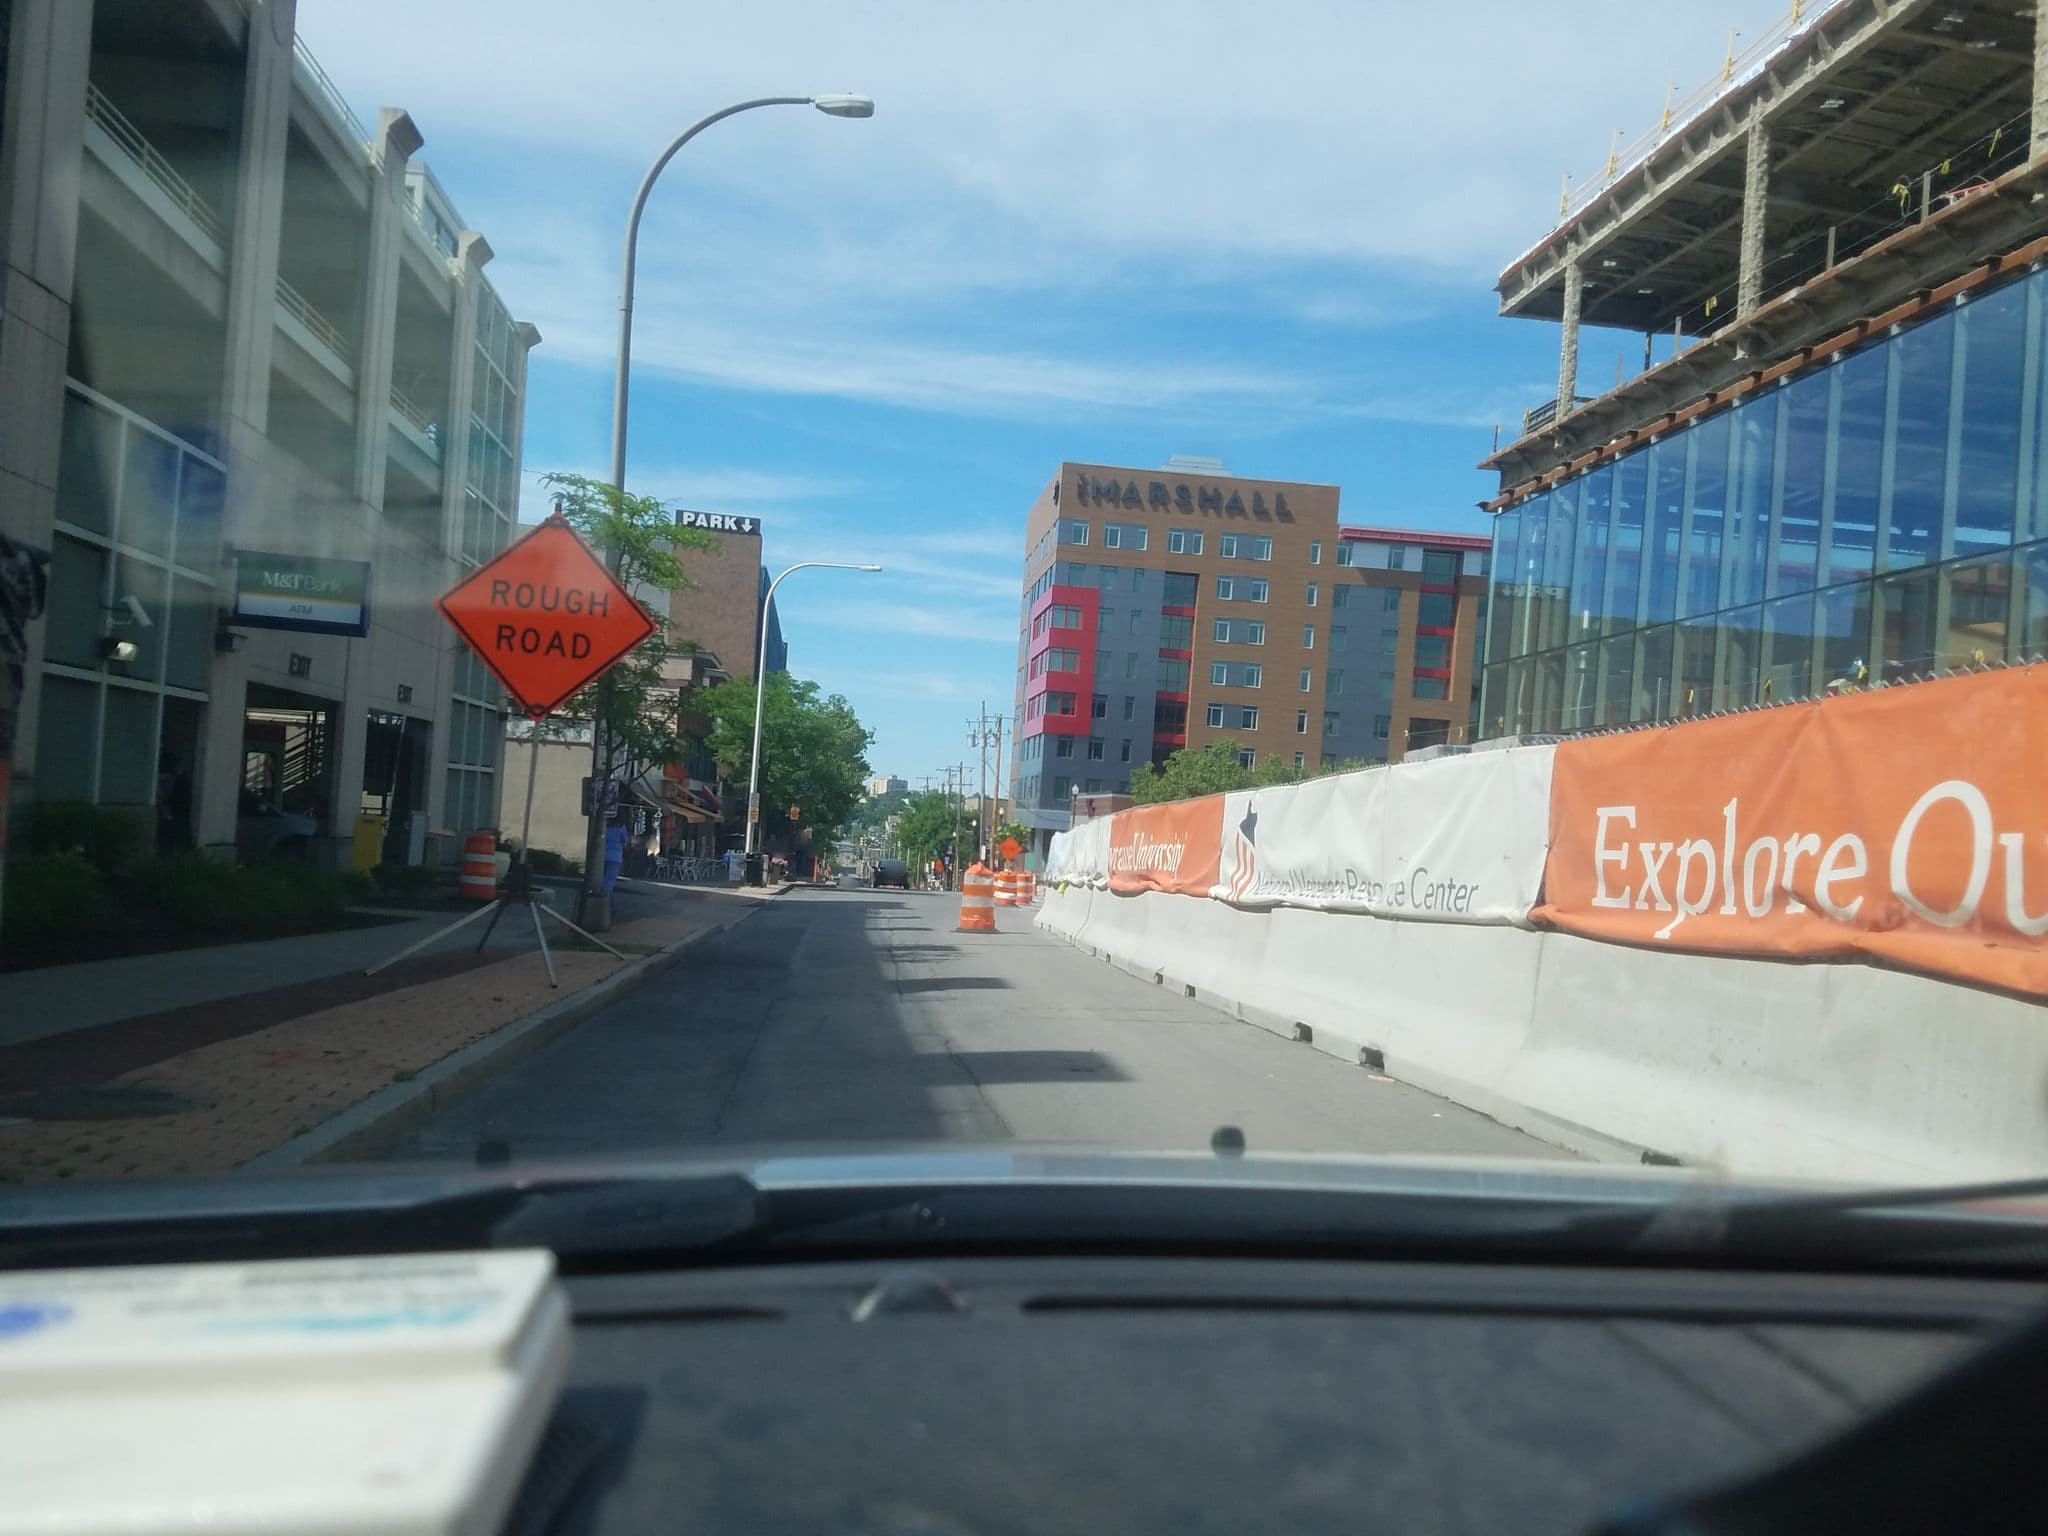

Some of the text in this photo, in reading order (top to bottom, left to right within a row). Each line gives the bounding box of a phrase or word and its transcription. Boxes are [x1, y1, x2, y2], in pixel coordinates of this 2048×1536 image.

[1091, 476, 1292, 520] MARSHALL
[682, 511, 738, 531] PARK
[289, 604, 312, 615] ATM
[490, 579, 609, 617] ROUGH
[496, 624, 592, 659] ROAD
[1591, 797, 1868, 940] Explore
[1411, 866, 1480, 913] Center
